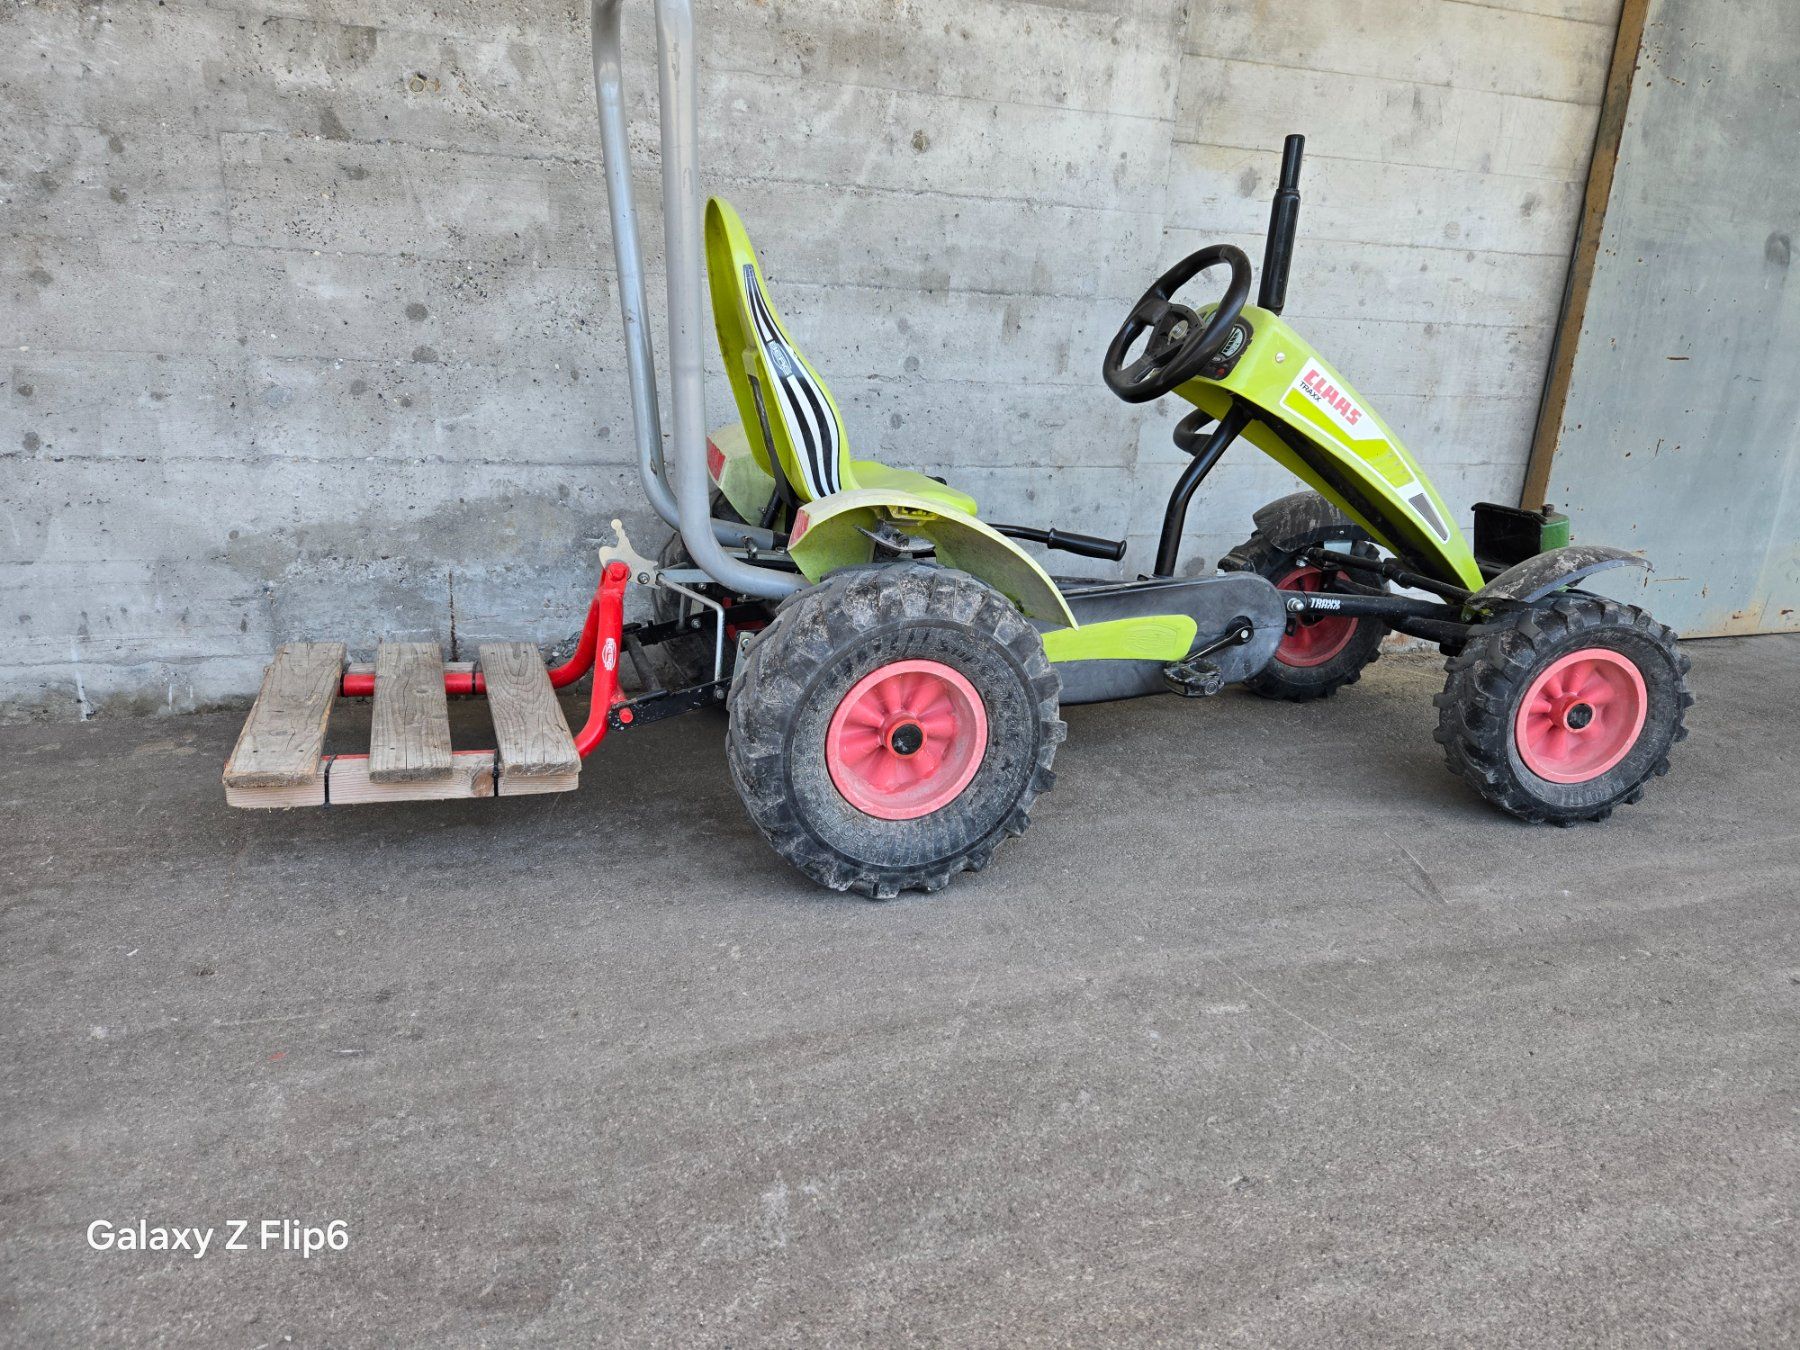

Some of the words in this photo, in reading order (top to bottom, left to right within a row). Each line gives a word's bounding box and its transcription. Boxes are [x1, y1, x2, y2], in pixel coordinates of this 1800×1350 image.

[1299, 381, 1321, 402] TRAXX
[1303, 369, 1362, 425] CLAAS
[1310, 597, 1341, 610] TRAXX
